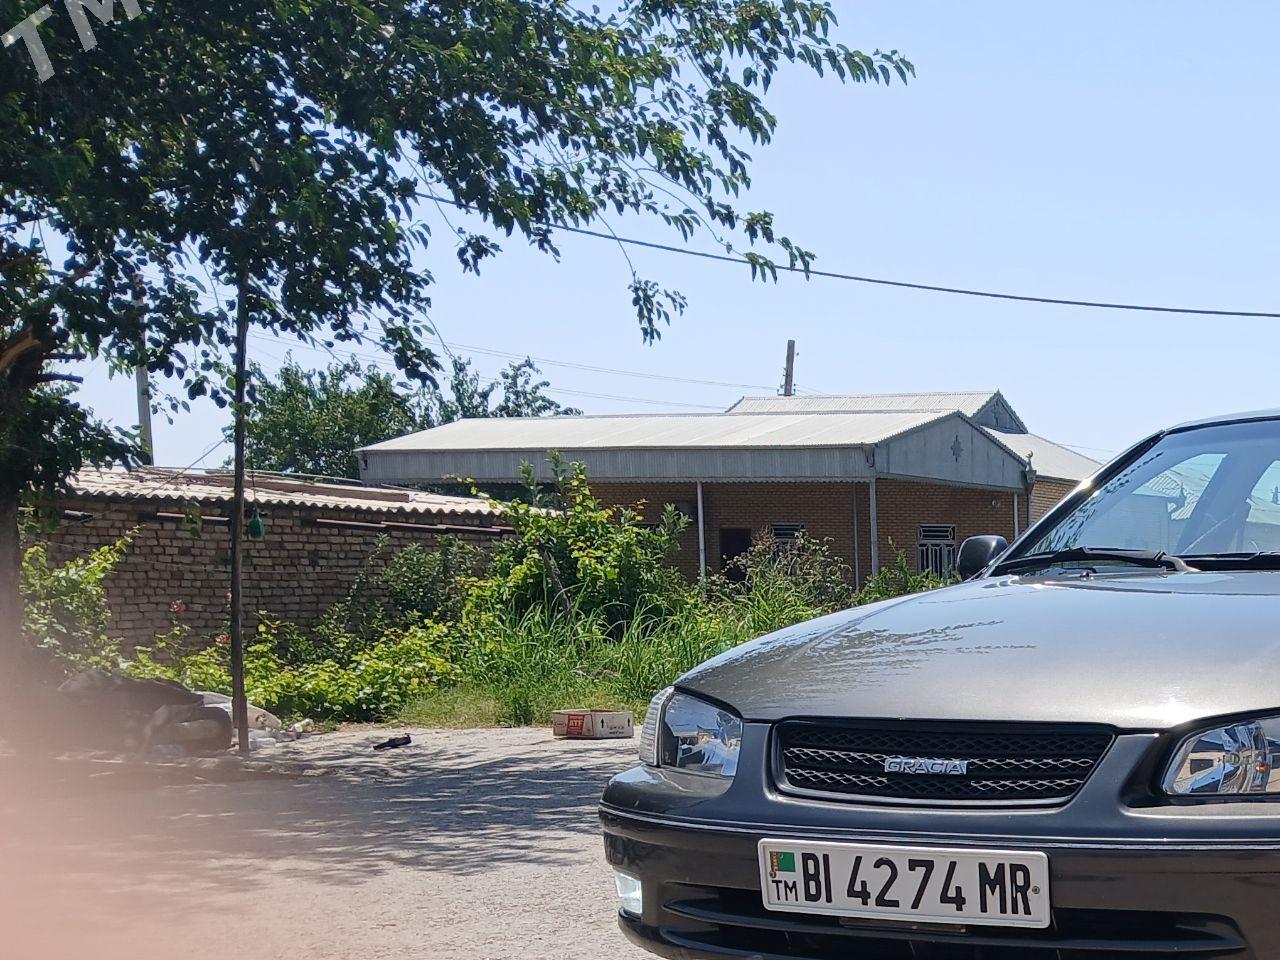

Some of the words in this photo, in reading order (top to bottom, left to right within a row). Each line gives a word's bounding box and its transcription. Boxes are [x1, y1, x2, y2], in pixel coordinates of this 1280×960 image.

[885, 759, 967, 775] GRACIA
[771, 880, 798, 901] TM
[801, 852, 832, 903] BI
[847, 856, 966, 911] 4274
[978, 862, 1031, 915] MR
